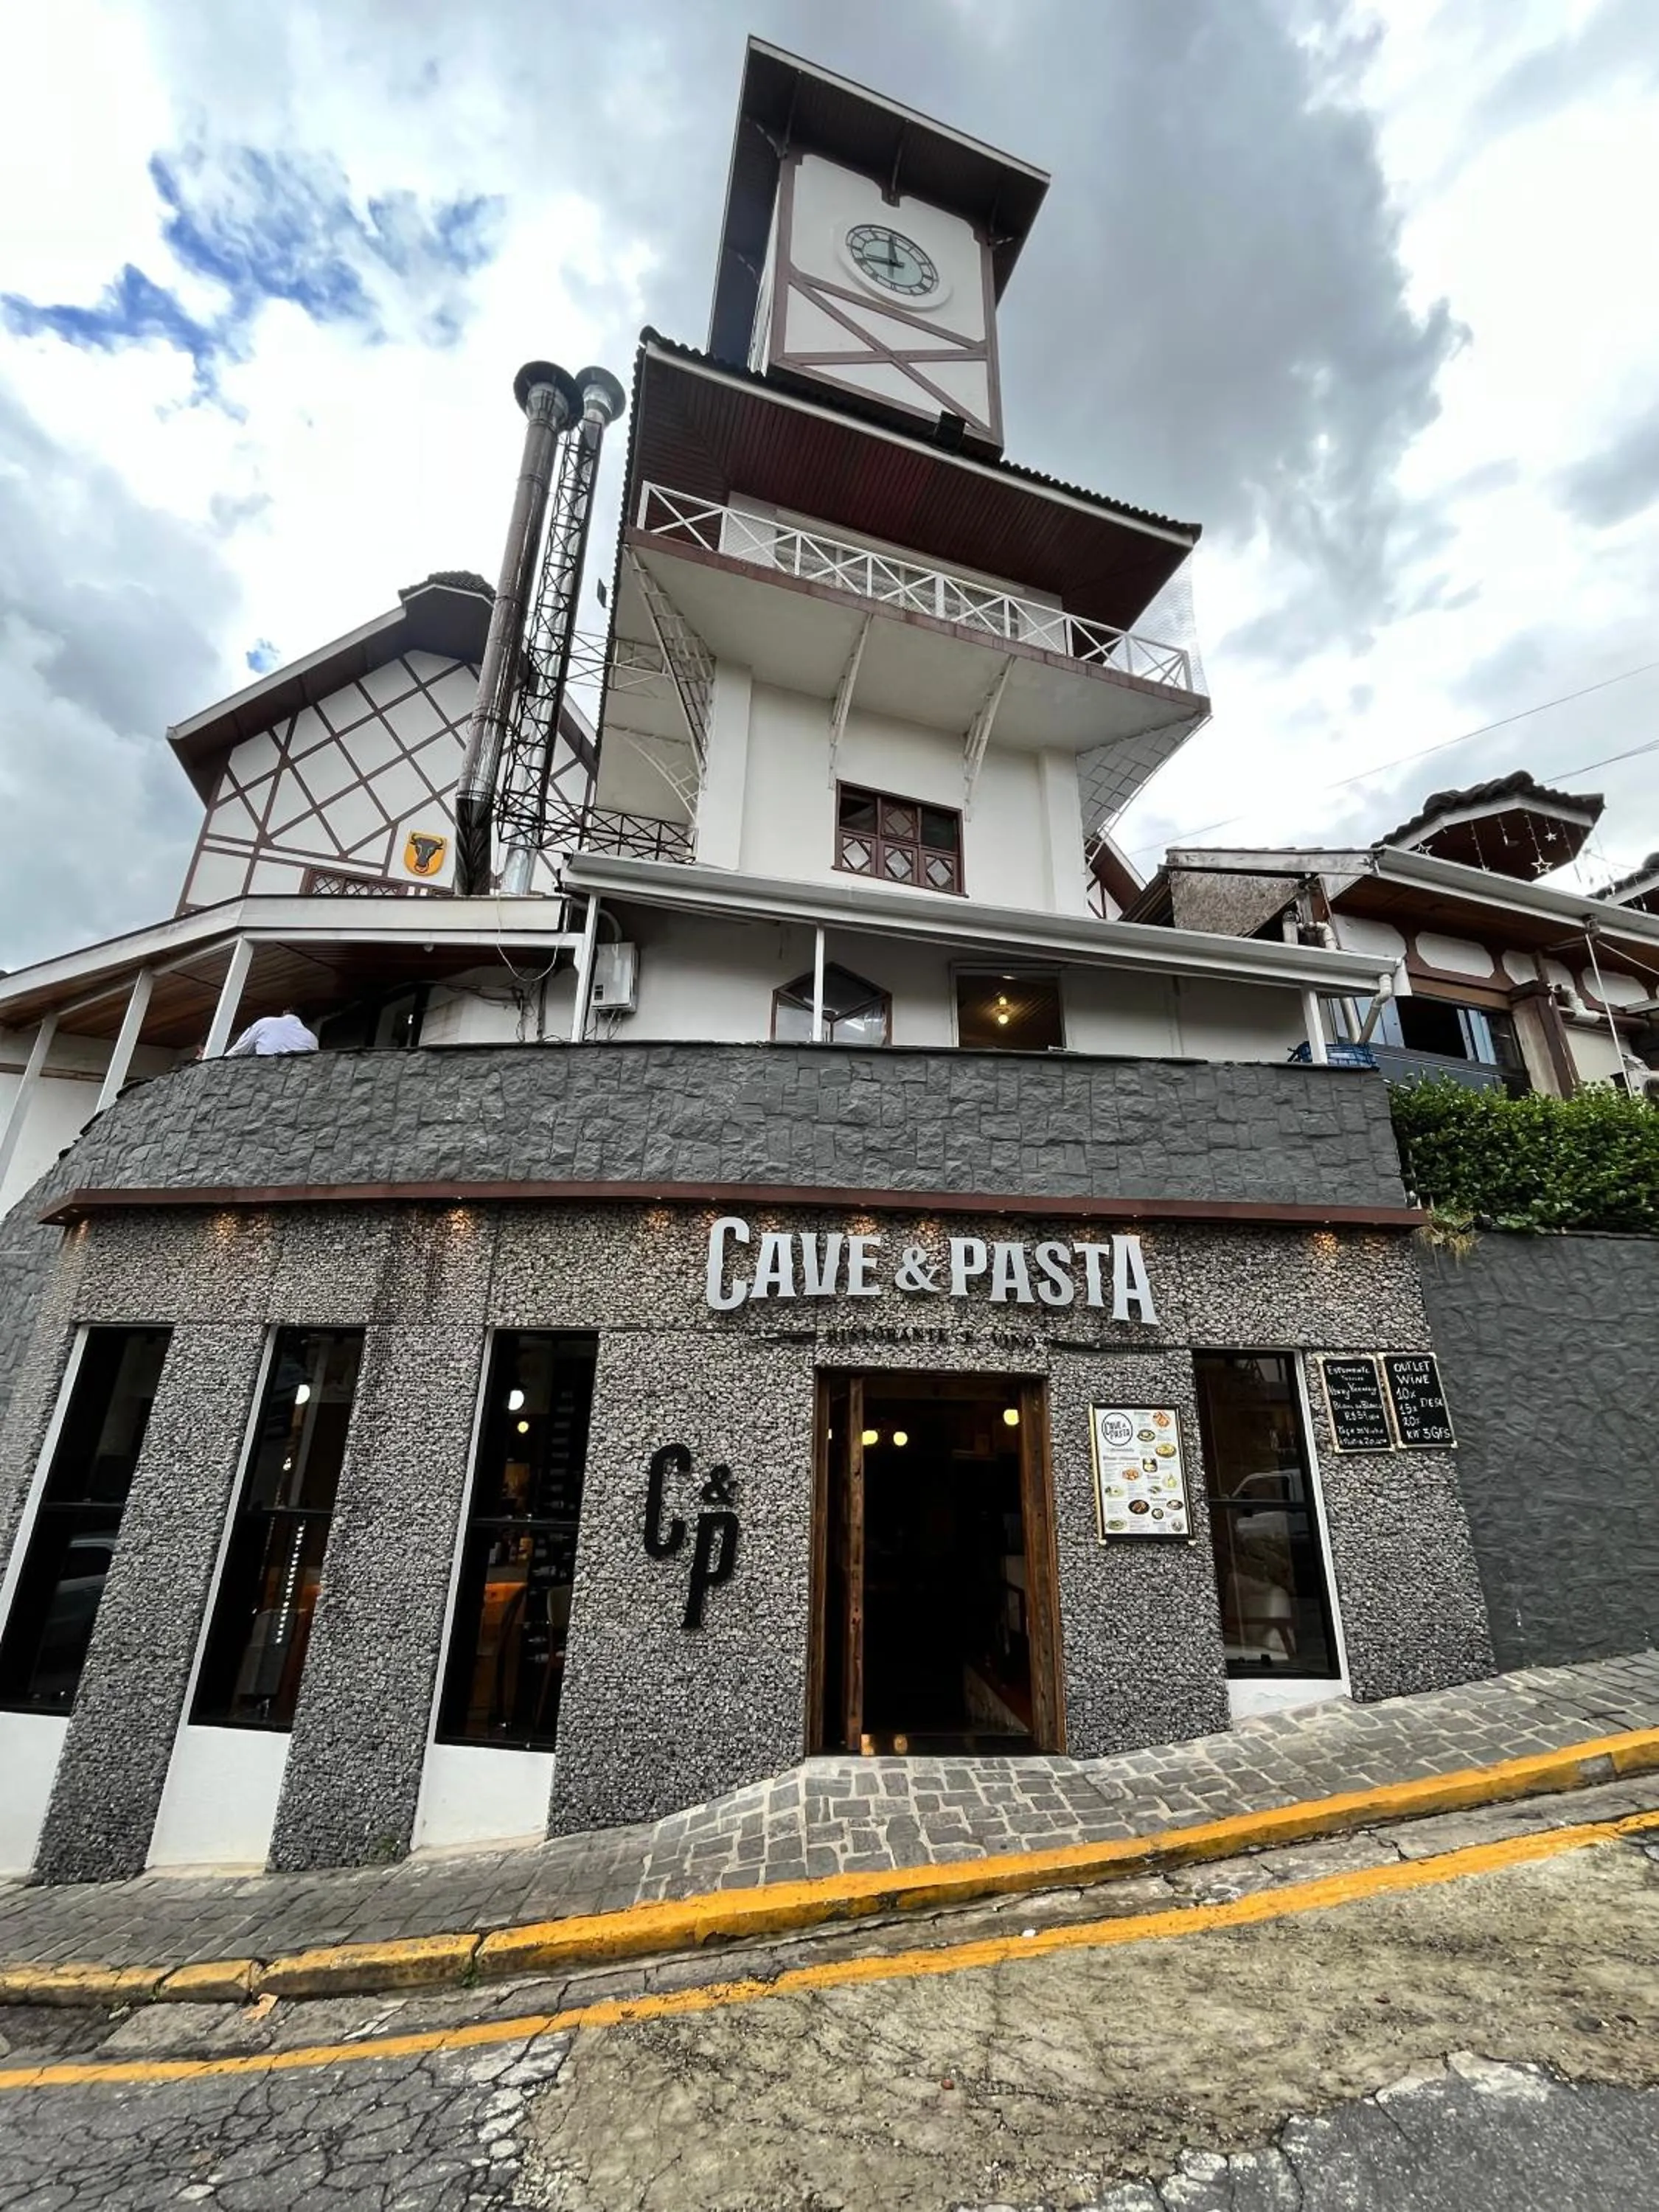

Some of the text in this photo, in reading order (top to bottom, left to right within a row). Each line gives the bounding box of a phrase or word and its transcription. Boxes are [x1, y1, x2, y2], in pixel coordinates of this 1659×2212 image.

[706, 1217, 1159, 1325] CAVE & PASTA
[1394, 1361, 1430, 1372] OUTLET
[1396, 1374, 1430, 1384] WINE
[701, 1464, 738, 1505] &
